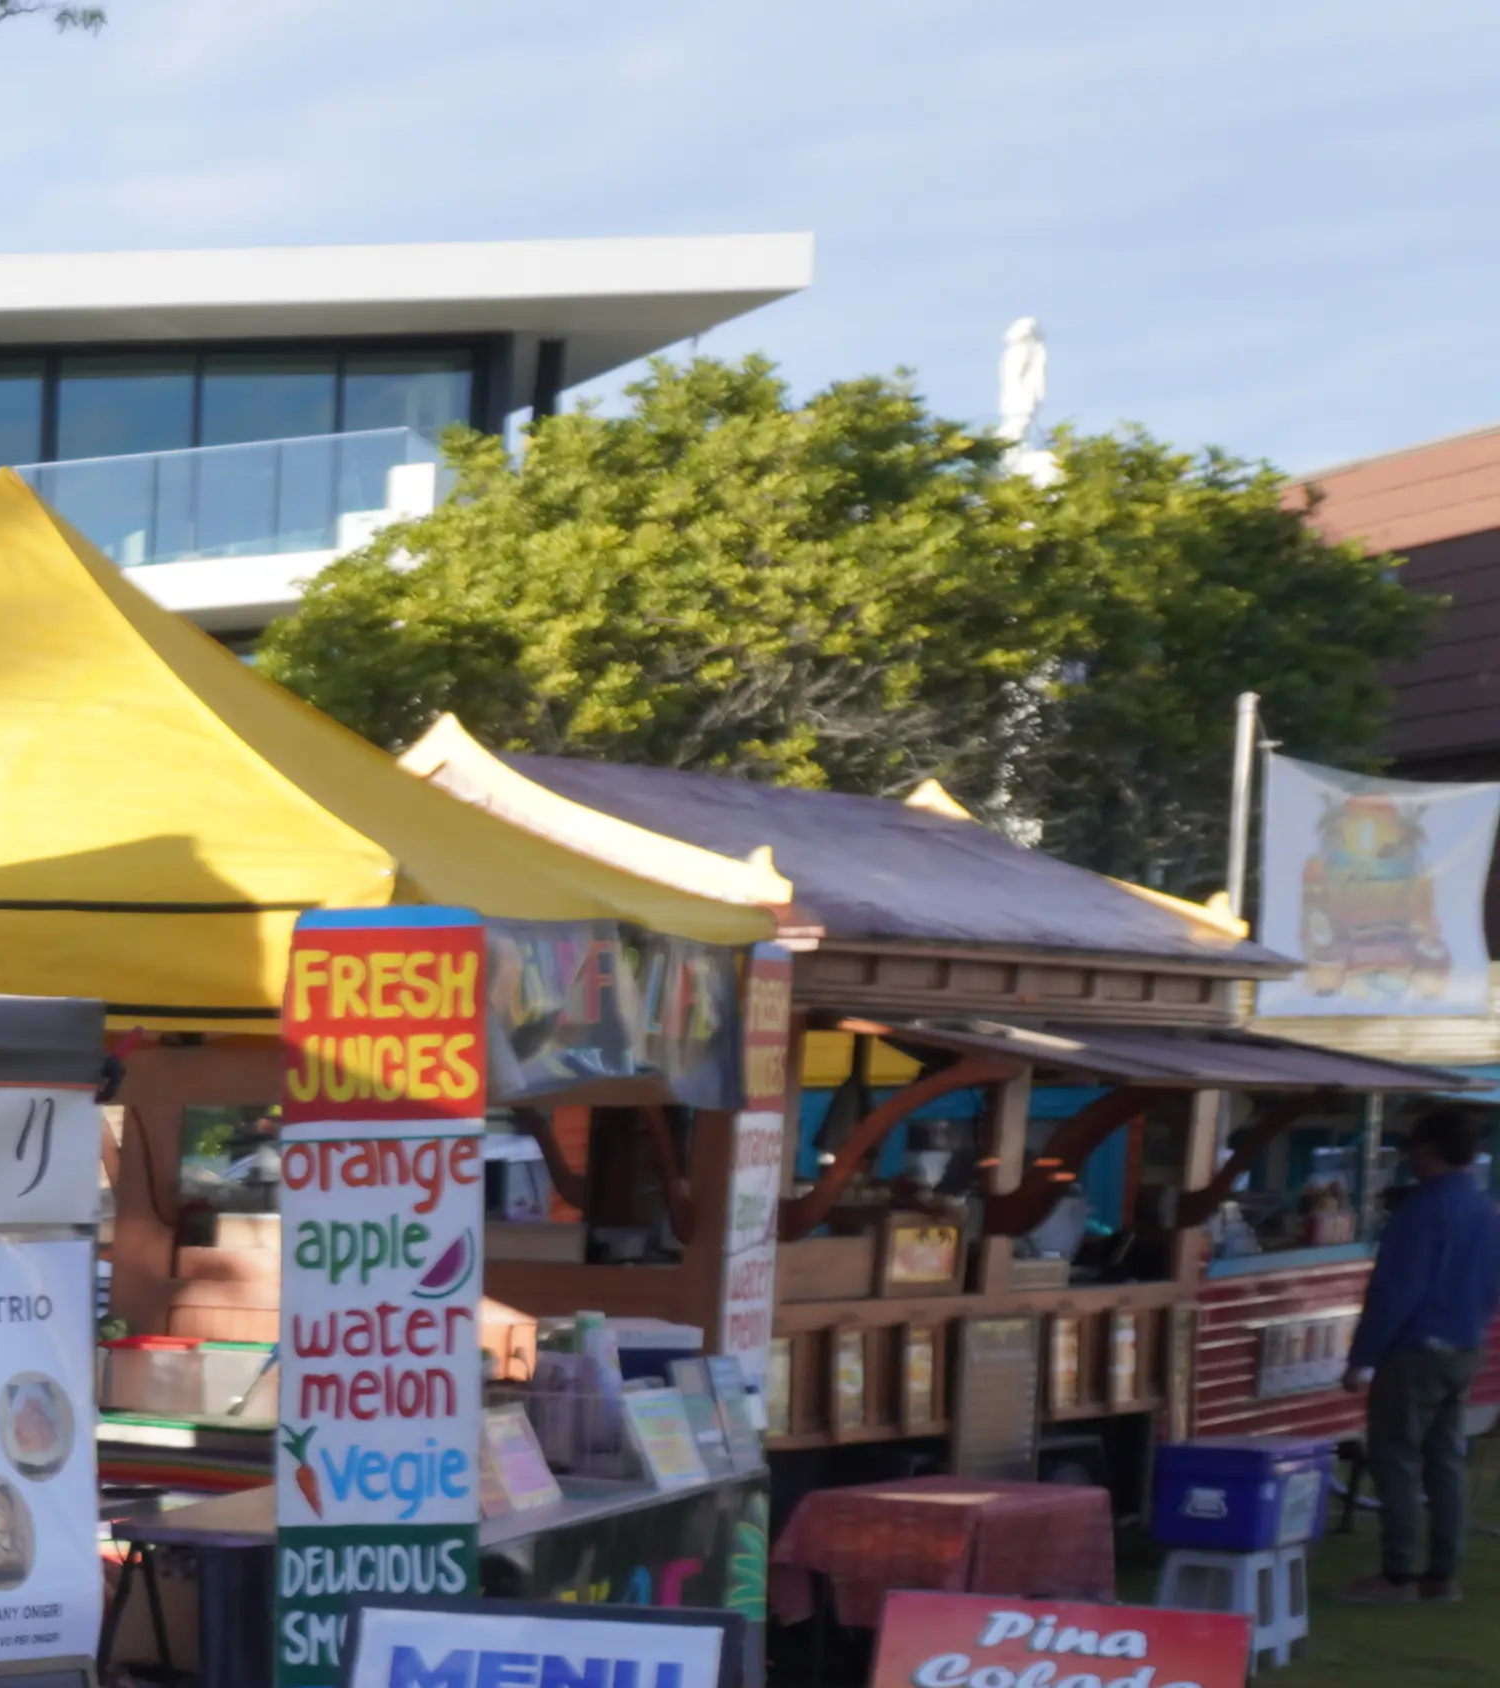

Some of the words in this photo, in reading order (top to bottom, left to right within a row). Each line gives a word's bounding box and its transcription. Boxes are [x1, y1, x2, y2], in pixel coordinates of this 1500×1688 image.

[292, 950, 479, 1021] FRESH
[288, 1032, 480, 1102] JUICES
[281, 1138, 481, 1214] orange
[295, 1214, 432, 1287] apple
[291, 1302, 474, 1358] water
[299, 1363, 456, 1420] melon
[282, 1538, 466, 1597] DELICIOUS
[23, 1603, 63, 1620] ONIGIRI
[282, 1610, 346, 1666] SM
[979, 1609, 1147, 1661] Pina
